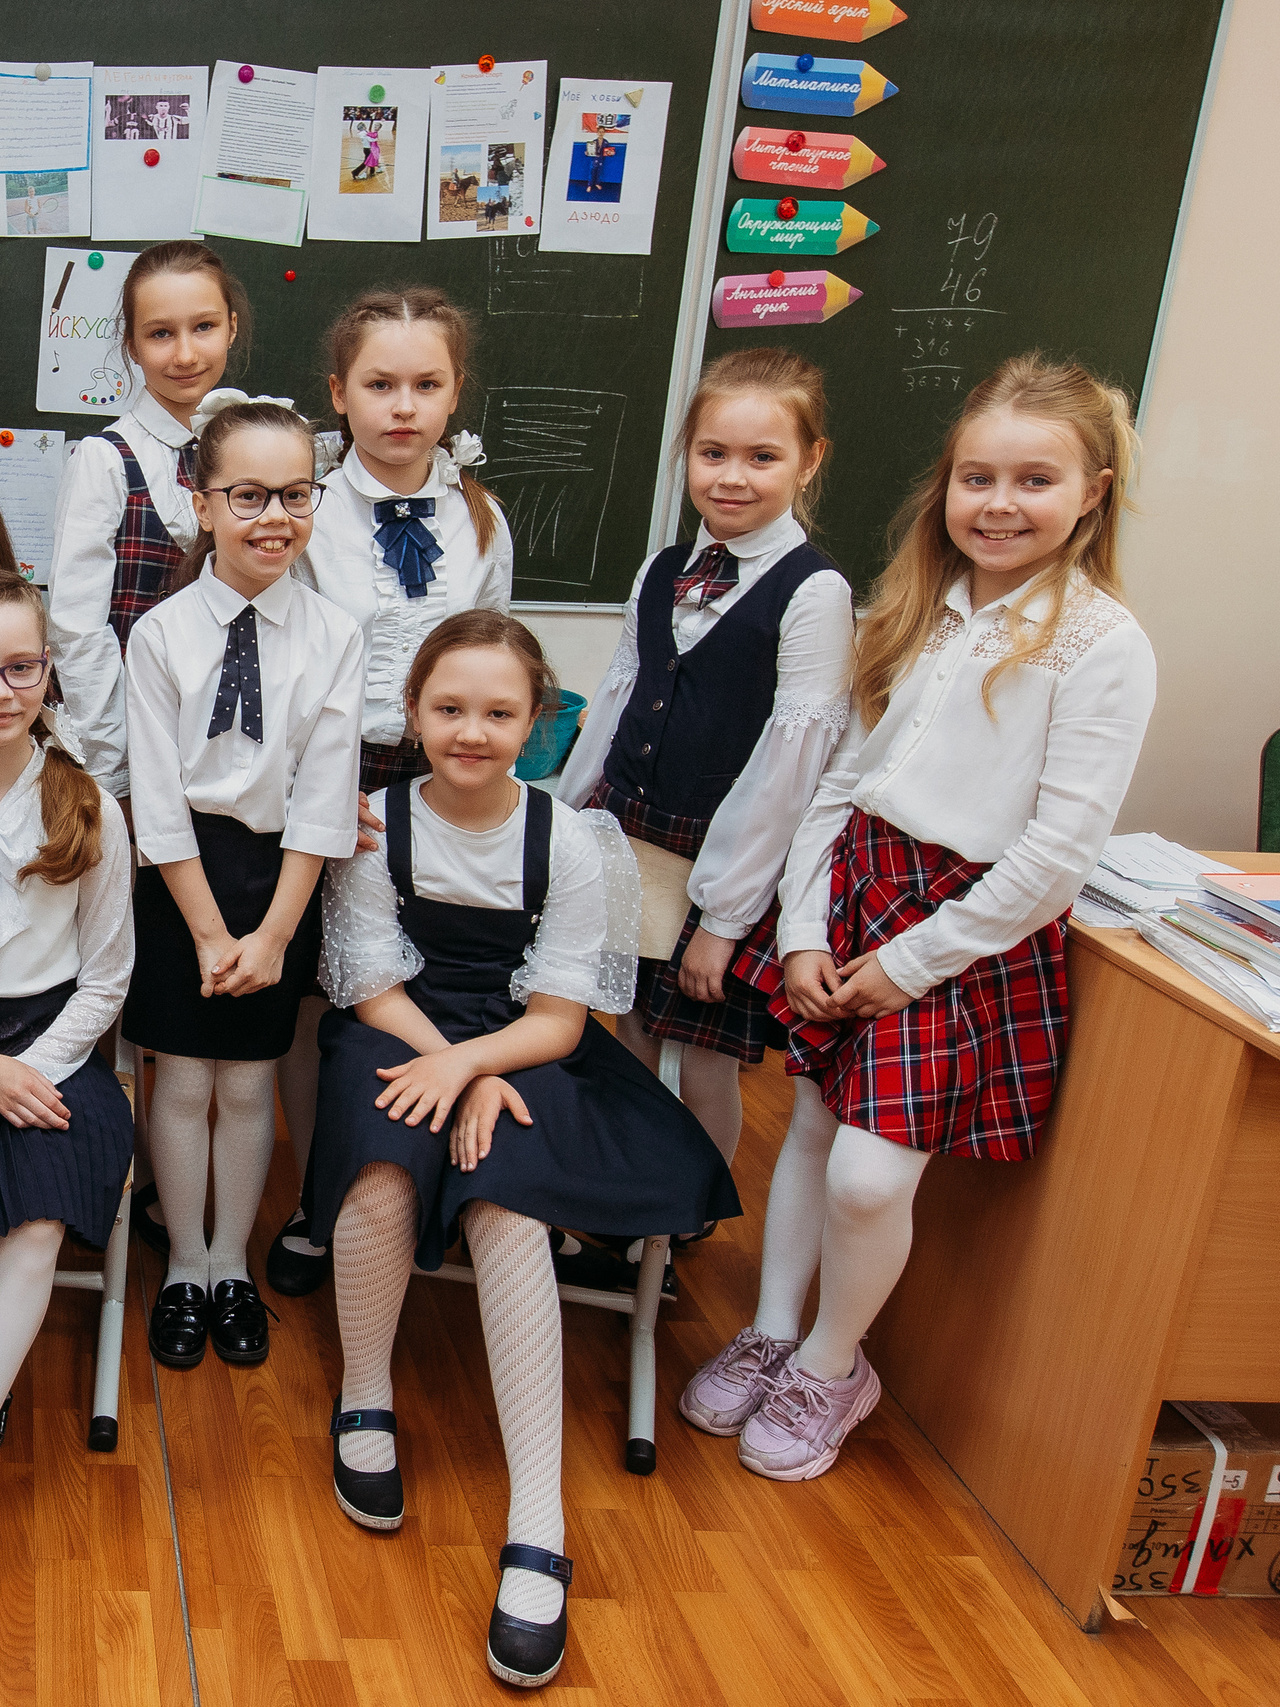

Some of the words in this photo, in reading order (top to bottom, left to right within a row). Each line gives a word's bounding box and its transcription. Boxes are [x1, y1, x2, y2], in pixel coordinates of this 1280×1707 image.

[762, 0, 825, 14] усский
[827, 5, 870, 22] язык
[752, 69, 861, 94] Математика
[743, 138, 852, 164] Литературное
[769, 160, 819, 174] чтение
[567, 211, 620, 224] ДЗЮДО
[737, 212, 842, 236] Окружающий
[769, 232, 806, 249] мир
[947, 212, 998, 263] 79
[726, 283, 819, 301] Английский
[940, 267, 987, 305] 46
[752, 301, 790, 320] язык
[48, 314, 126, 340] ИСКУССТ
[912, 337, 950, 359] 316
